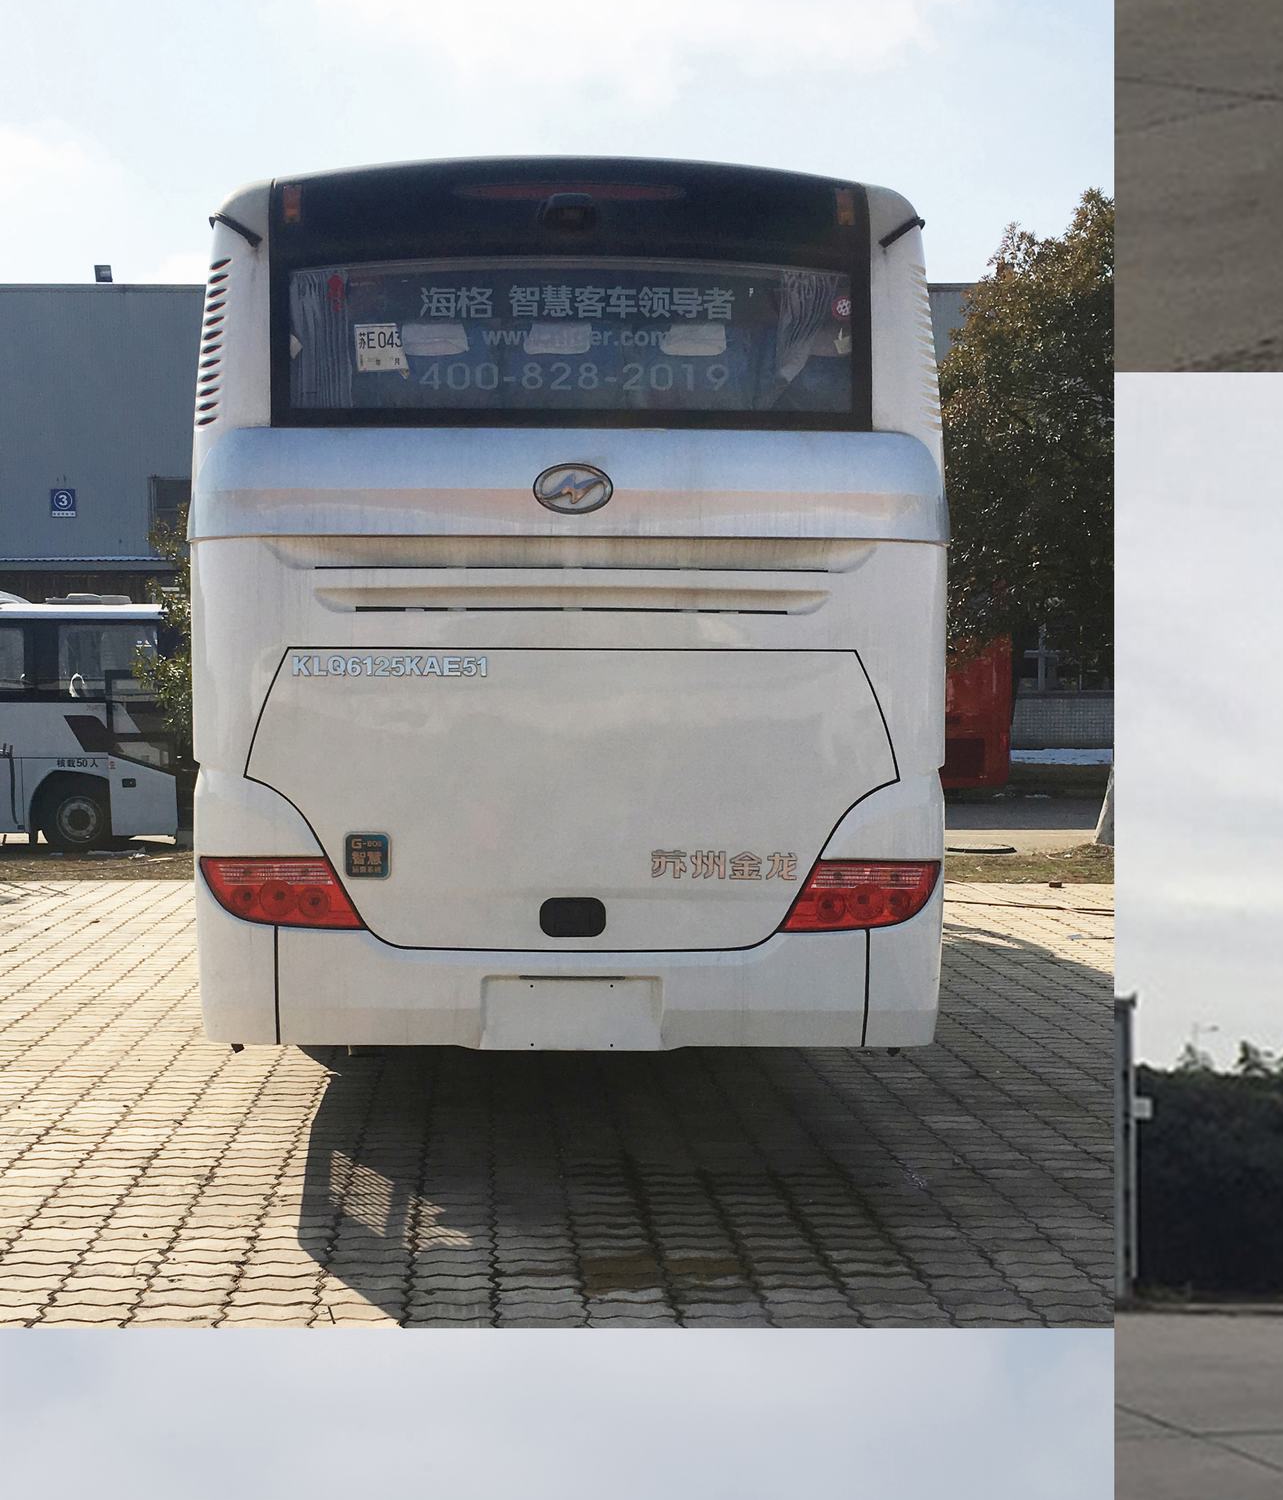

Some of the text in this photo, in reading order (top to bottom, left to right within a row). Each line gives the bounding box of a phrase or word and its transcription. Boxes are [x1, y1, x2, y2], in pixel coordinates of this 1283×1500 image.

[420, 284, 735, 319] 海格 智慧客车领导者
[420, 362, 729, 390] 400-828-2019
[292, 655, 488, 677] KLQ6125KAE51
[651, 850, 798, 881] 苏州金龙
